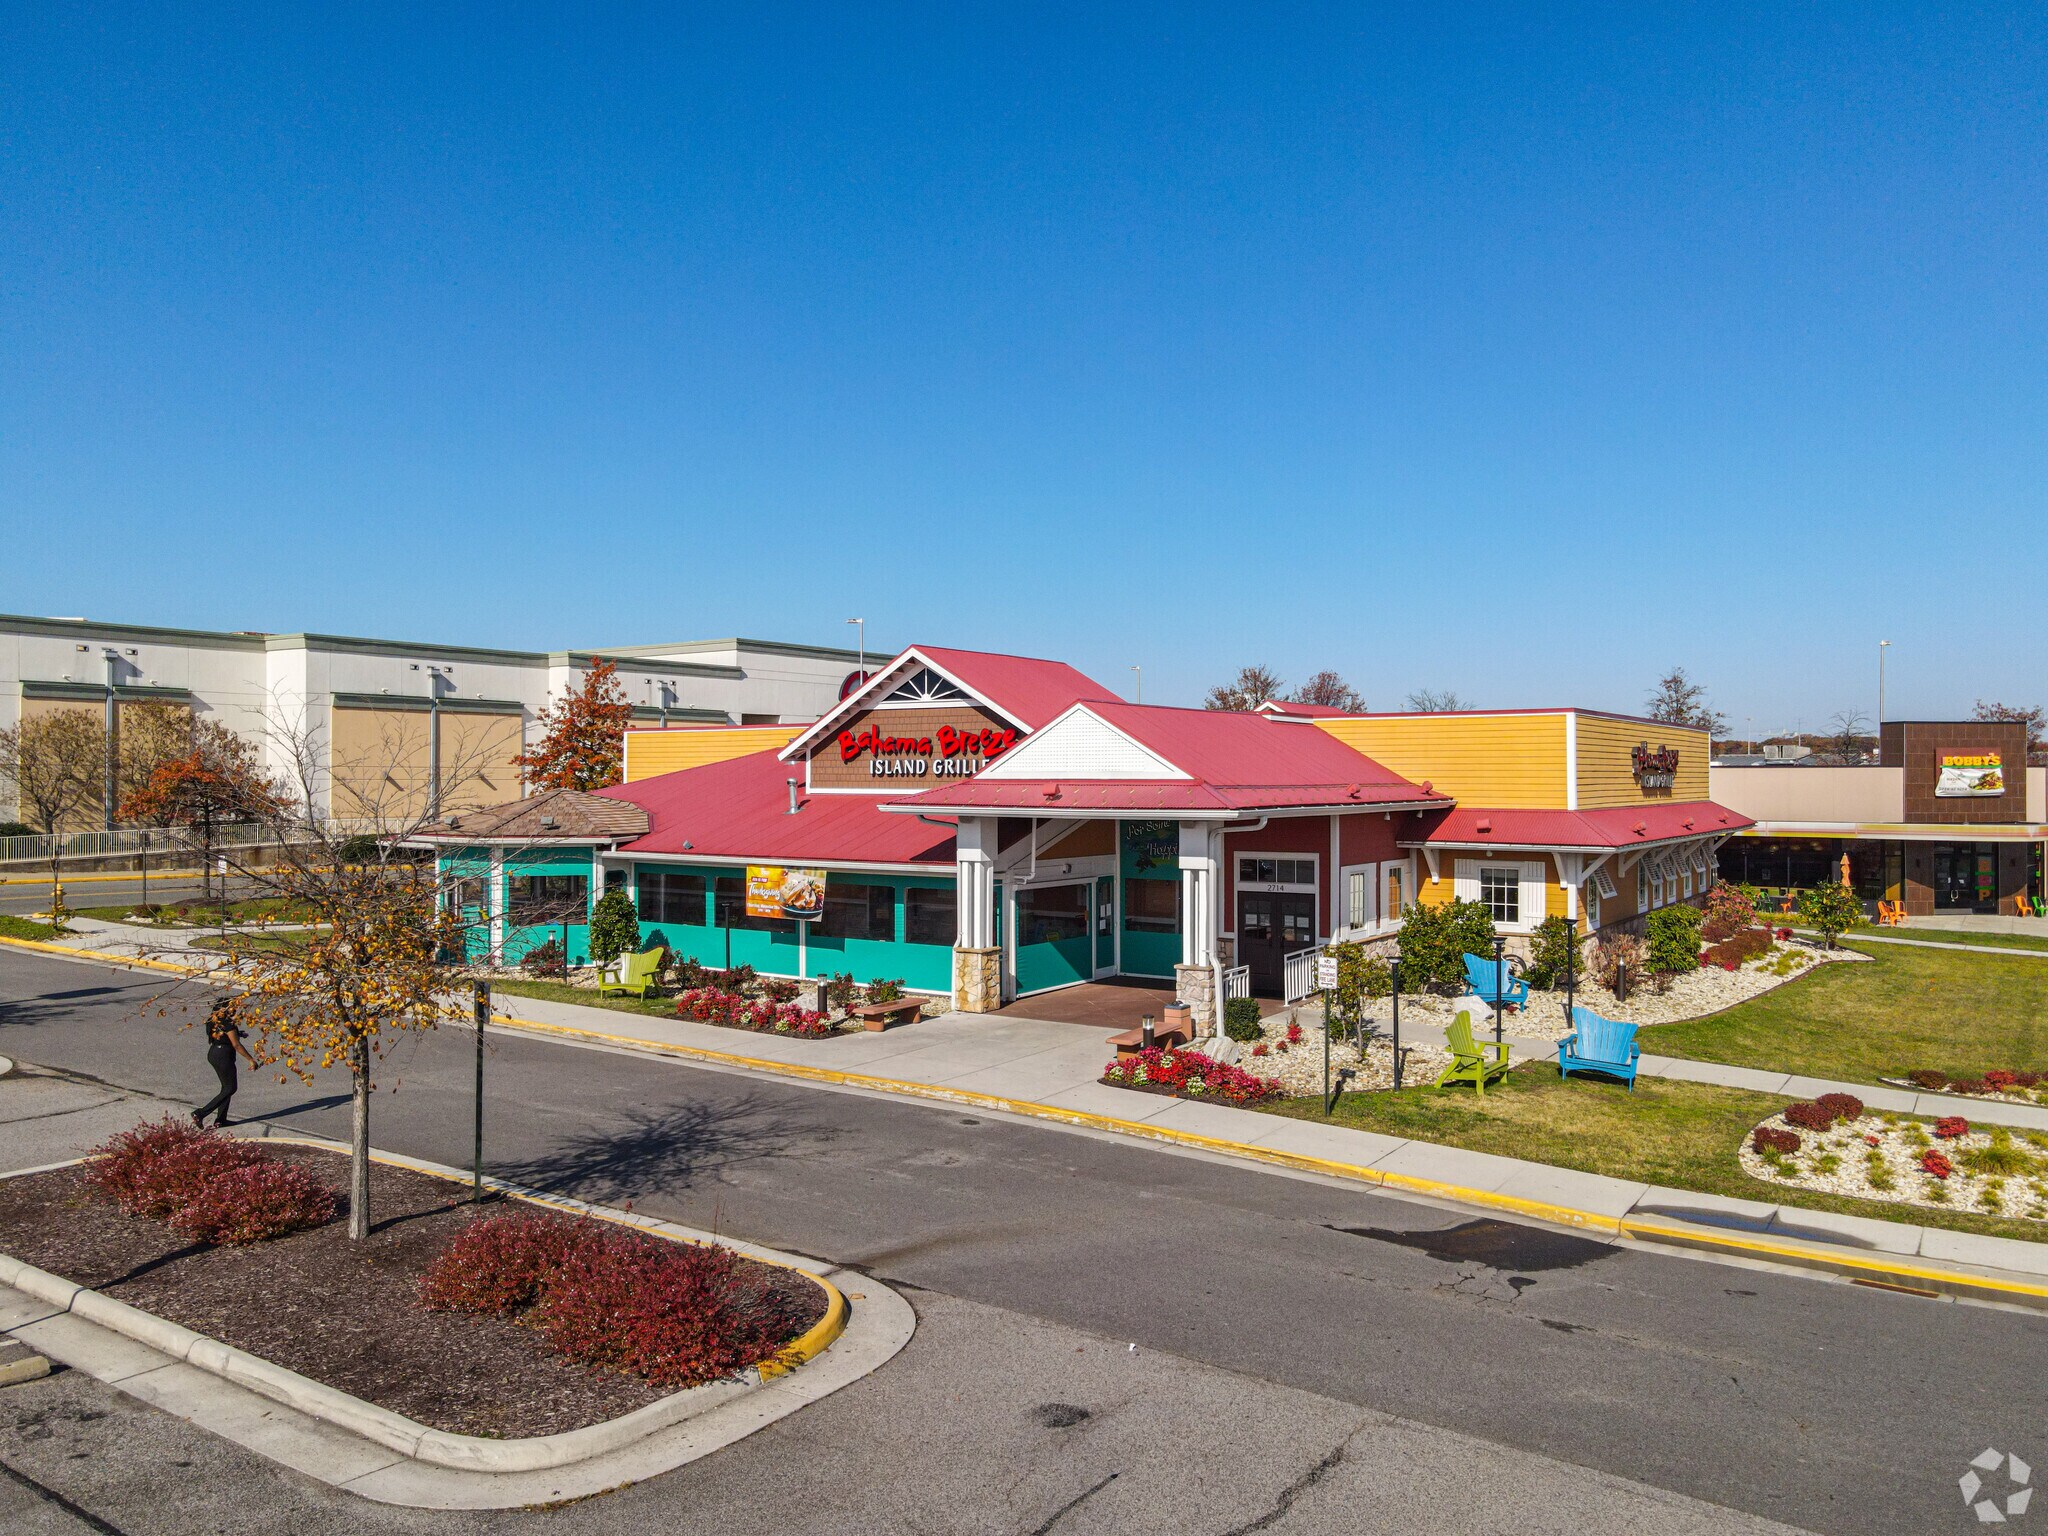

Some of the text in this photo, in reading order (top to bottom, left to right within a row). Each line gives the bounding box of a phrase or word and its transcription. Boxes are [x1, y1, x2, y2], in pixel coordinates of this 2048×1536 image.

[837, 724, 1017, 761] Bahama Breeze
[869, 759, 926, 774] ISLAND
[1942, 753, 2001, 766] BOBBY'S
[1267, 884, 1284, 892] 2714
